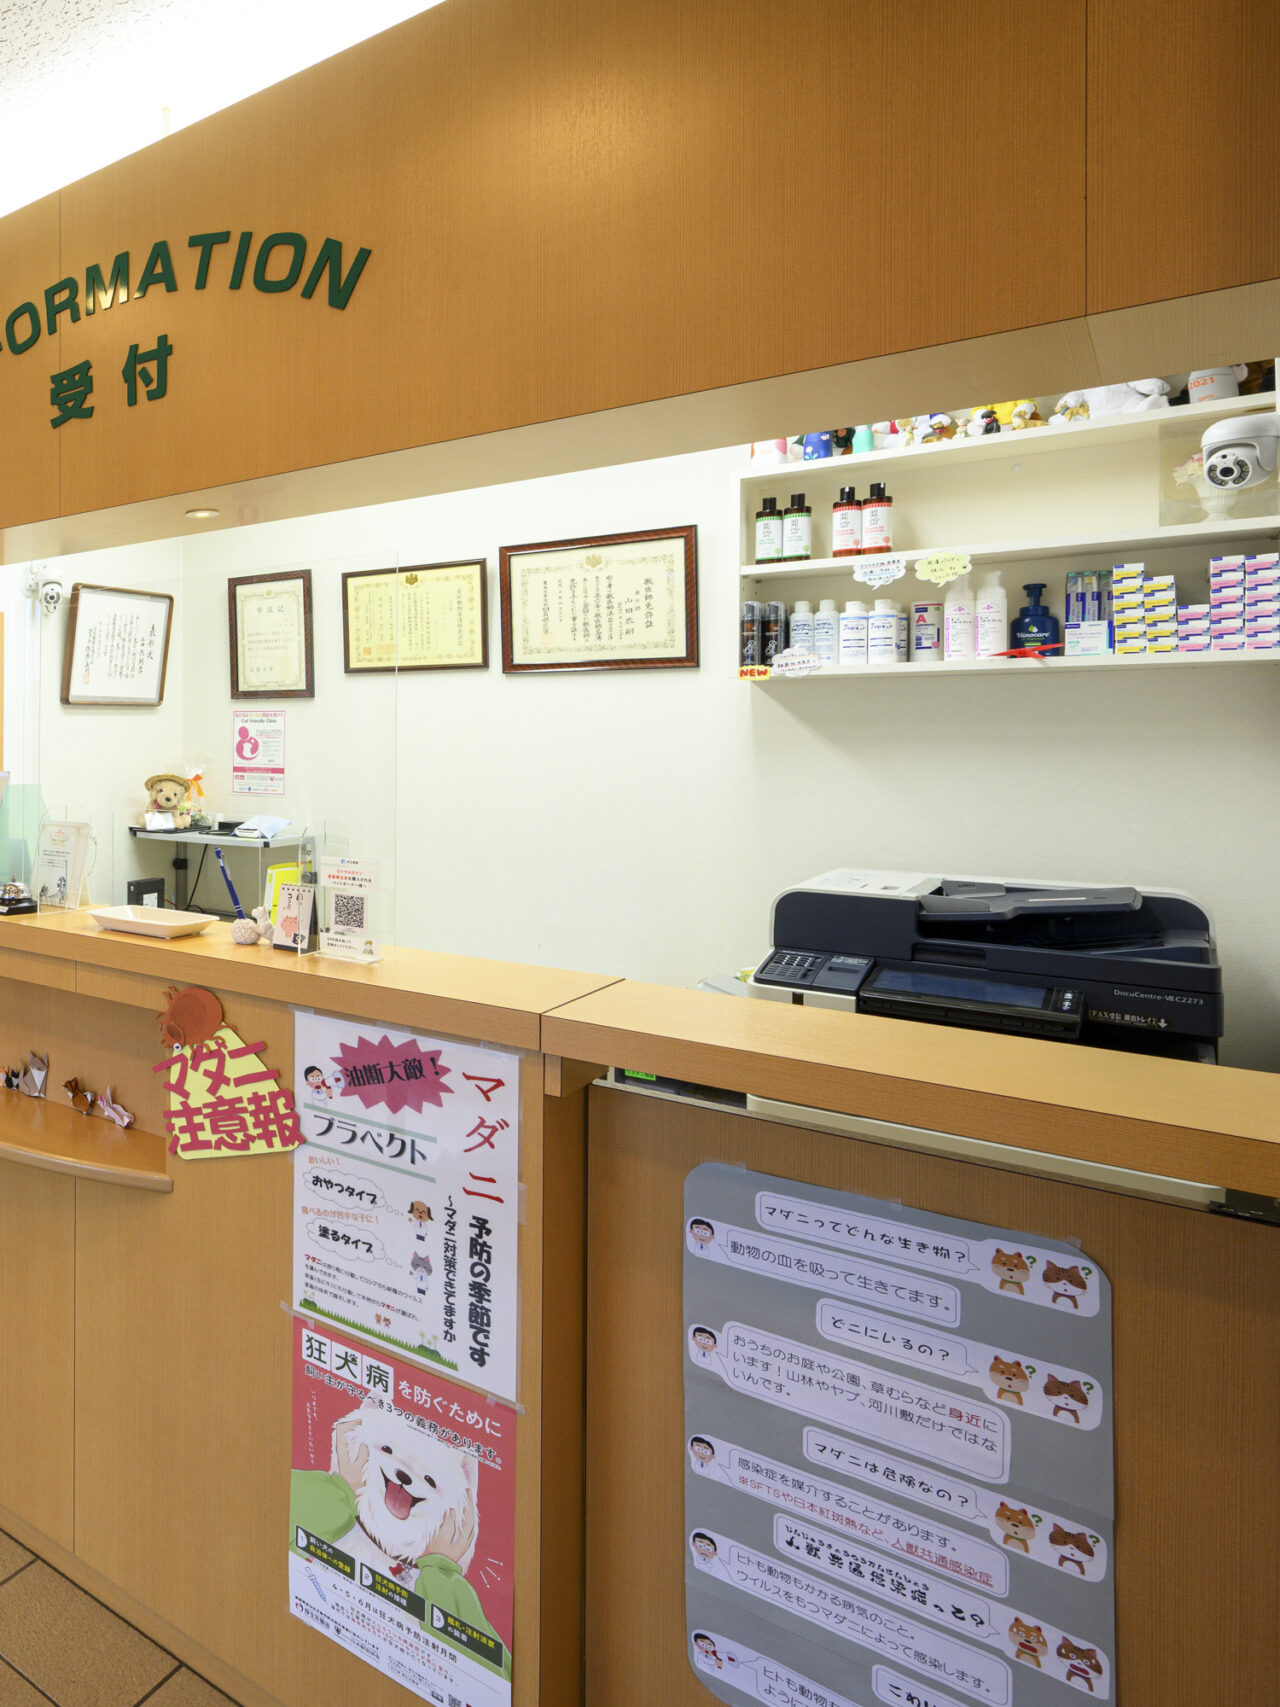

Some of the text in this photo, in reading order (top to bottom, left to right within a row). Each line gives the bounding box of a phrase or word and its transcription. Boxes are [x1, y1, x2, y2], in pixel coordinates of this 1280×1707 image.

[50, 334, 173, 429] 受付
[739, 669, 769, 677] NEW
[152, 1039, 280, 1101] マダニ
[163, 1088, 307, 1156] 注意報
[313, 1114, 428, 1165] ブラベクト
[312, 1175, 377, 1205] おやつタイプ
[318, 1225, 373, 1254] 塗るタイプ
[468, 1214, 493, 1368] 予防の季節です
[729, 1239, 951, 1312] 動物の血を吸って生きてます。
[397, 1379, 502, 1439] を防ぐために
[732, 1367, 792, 1397] いんです。
[732, 1334, 999, 1435] おうちのお庭や公園、草むらなど身近に
[737, 1457, 958, 1553] 感染症を媒介することがあります。
[736, 1551, 915, 1641] ヒトも動物もかかる病気のこと。
[736, 1567, 991, 1695] ウイルスをもつマダニによって感染します。
